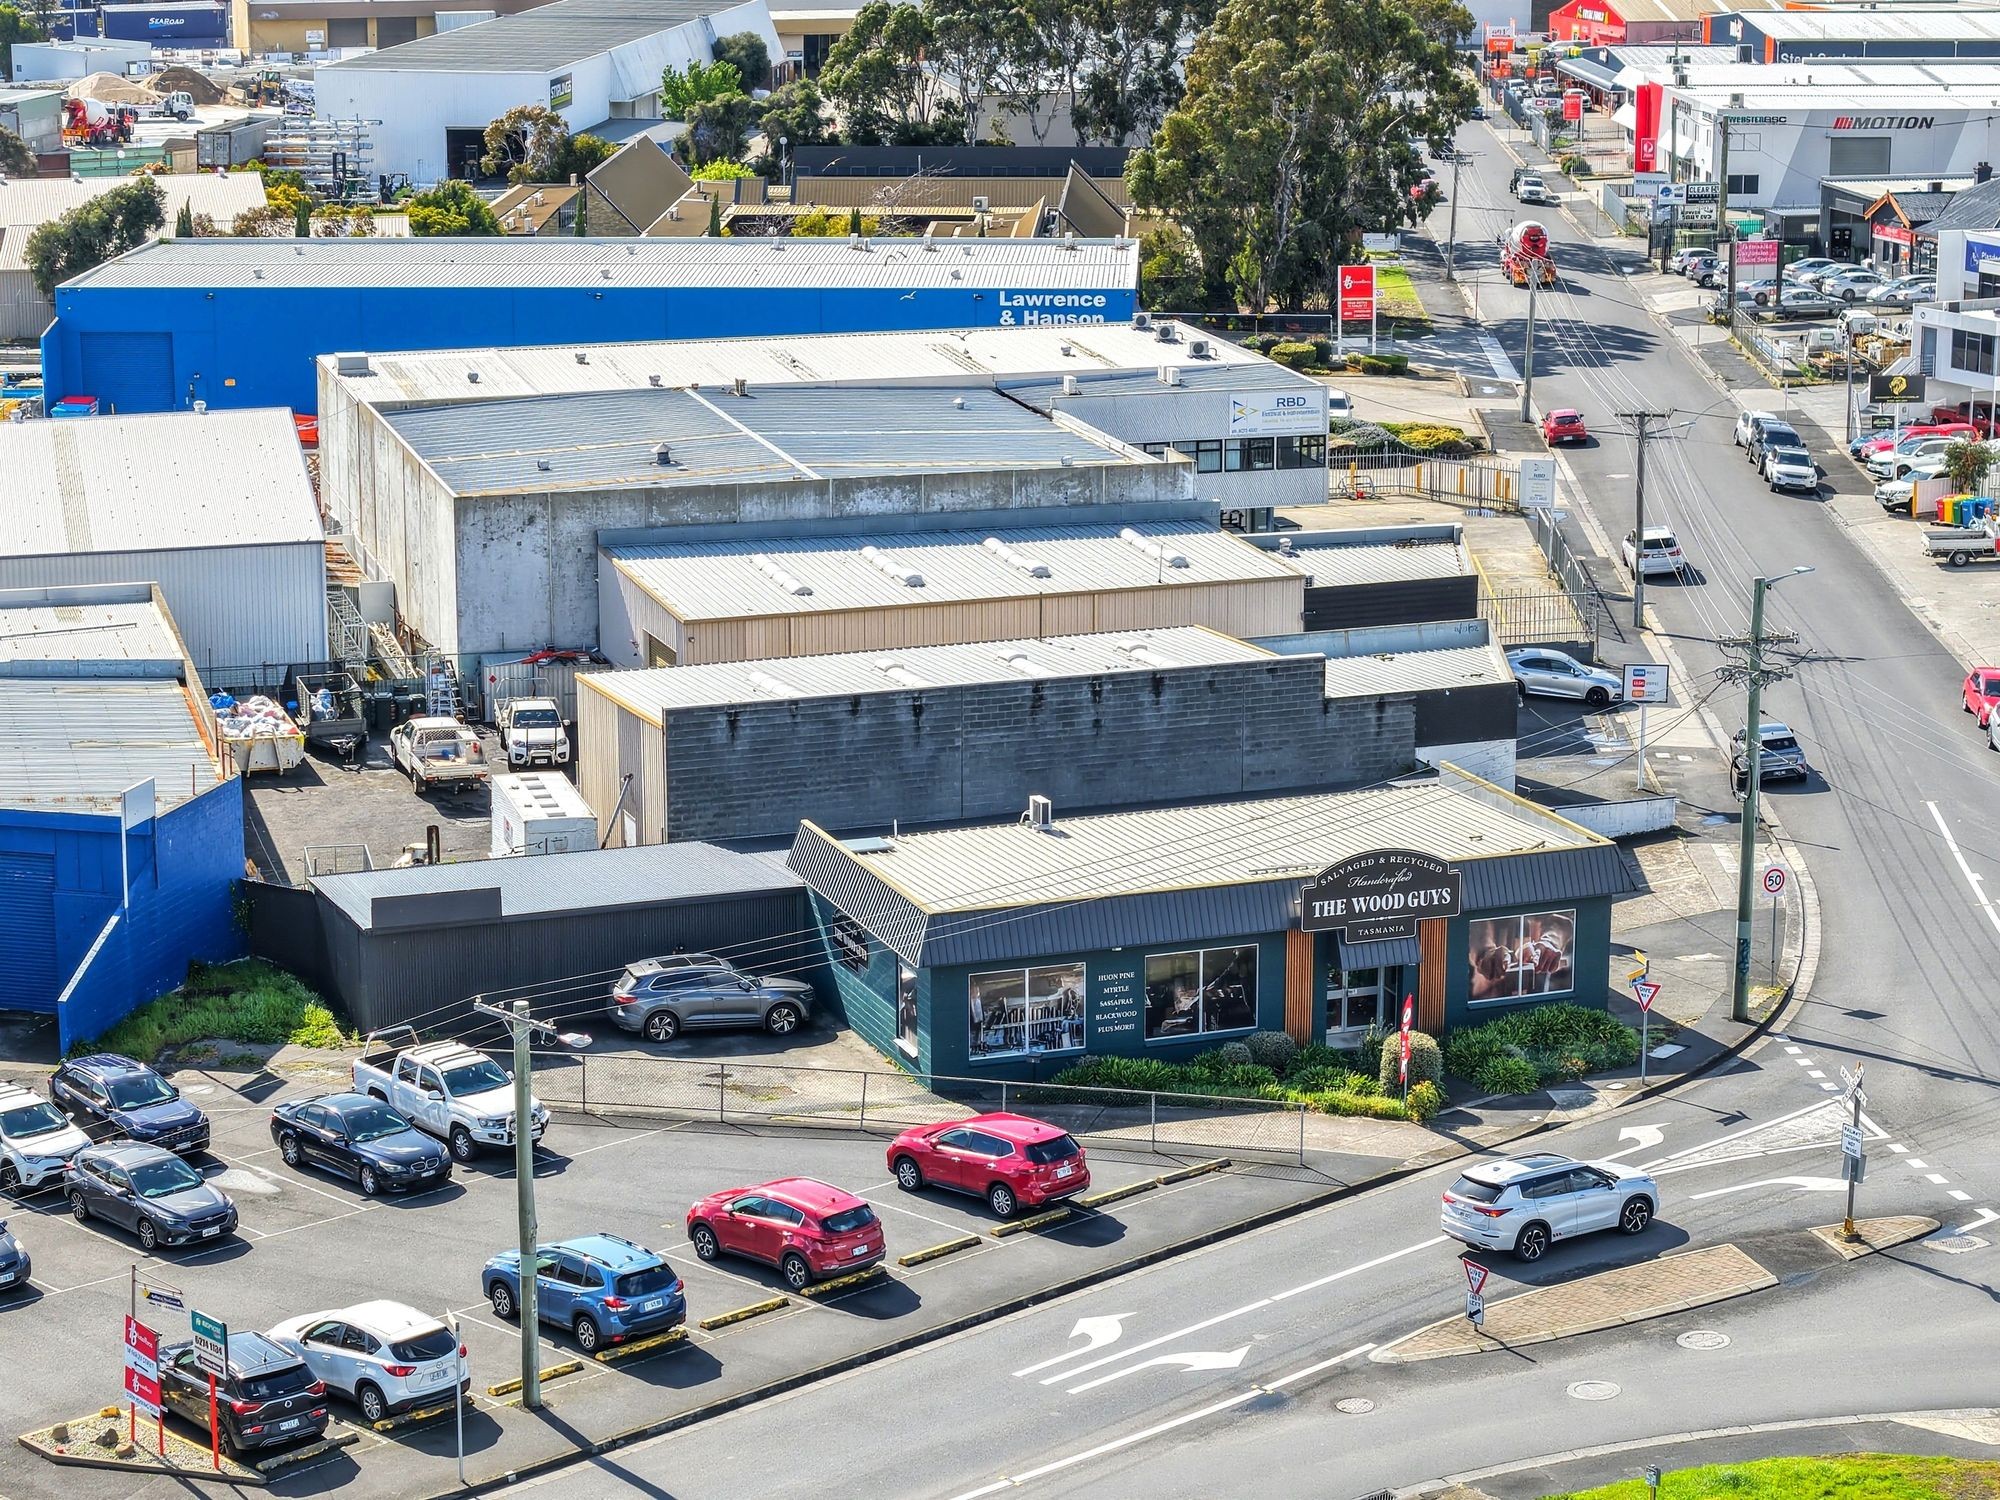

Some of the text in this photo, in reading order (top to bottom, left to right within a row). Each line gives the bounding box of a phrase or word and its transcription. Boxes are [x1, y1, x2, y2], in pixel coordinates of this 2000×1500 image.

[1852, 116, 1934, 129] MOTION
[1000, 291, 1106, 307] Lawrence
[1000, 311, 1104, 326] & Hanson
[1276, 397, 1306, 407] RBD
[1320, 856, 1443, 886] SALVAGED & RECYCLED
[1347, 868, 1413, 891] Handcrafted
[1768, 875, 1781, 886] 50
[1312, 887, 1451, 918] THE WOOD GUYS
[1358, 925, 1405, 936] TASMANIA
[1098, 971, 1135, 981] HUON PINE
[1103, 985, 1130, 994] MYRTLE
[1099, 997, 1133, 1007] SASSAFRAS
[1095, 1010, 1138, 1020] BLACKWOOD
[1097, 1025, 1114, 1033] PLUS
